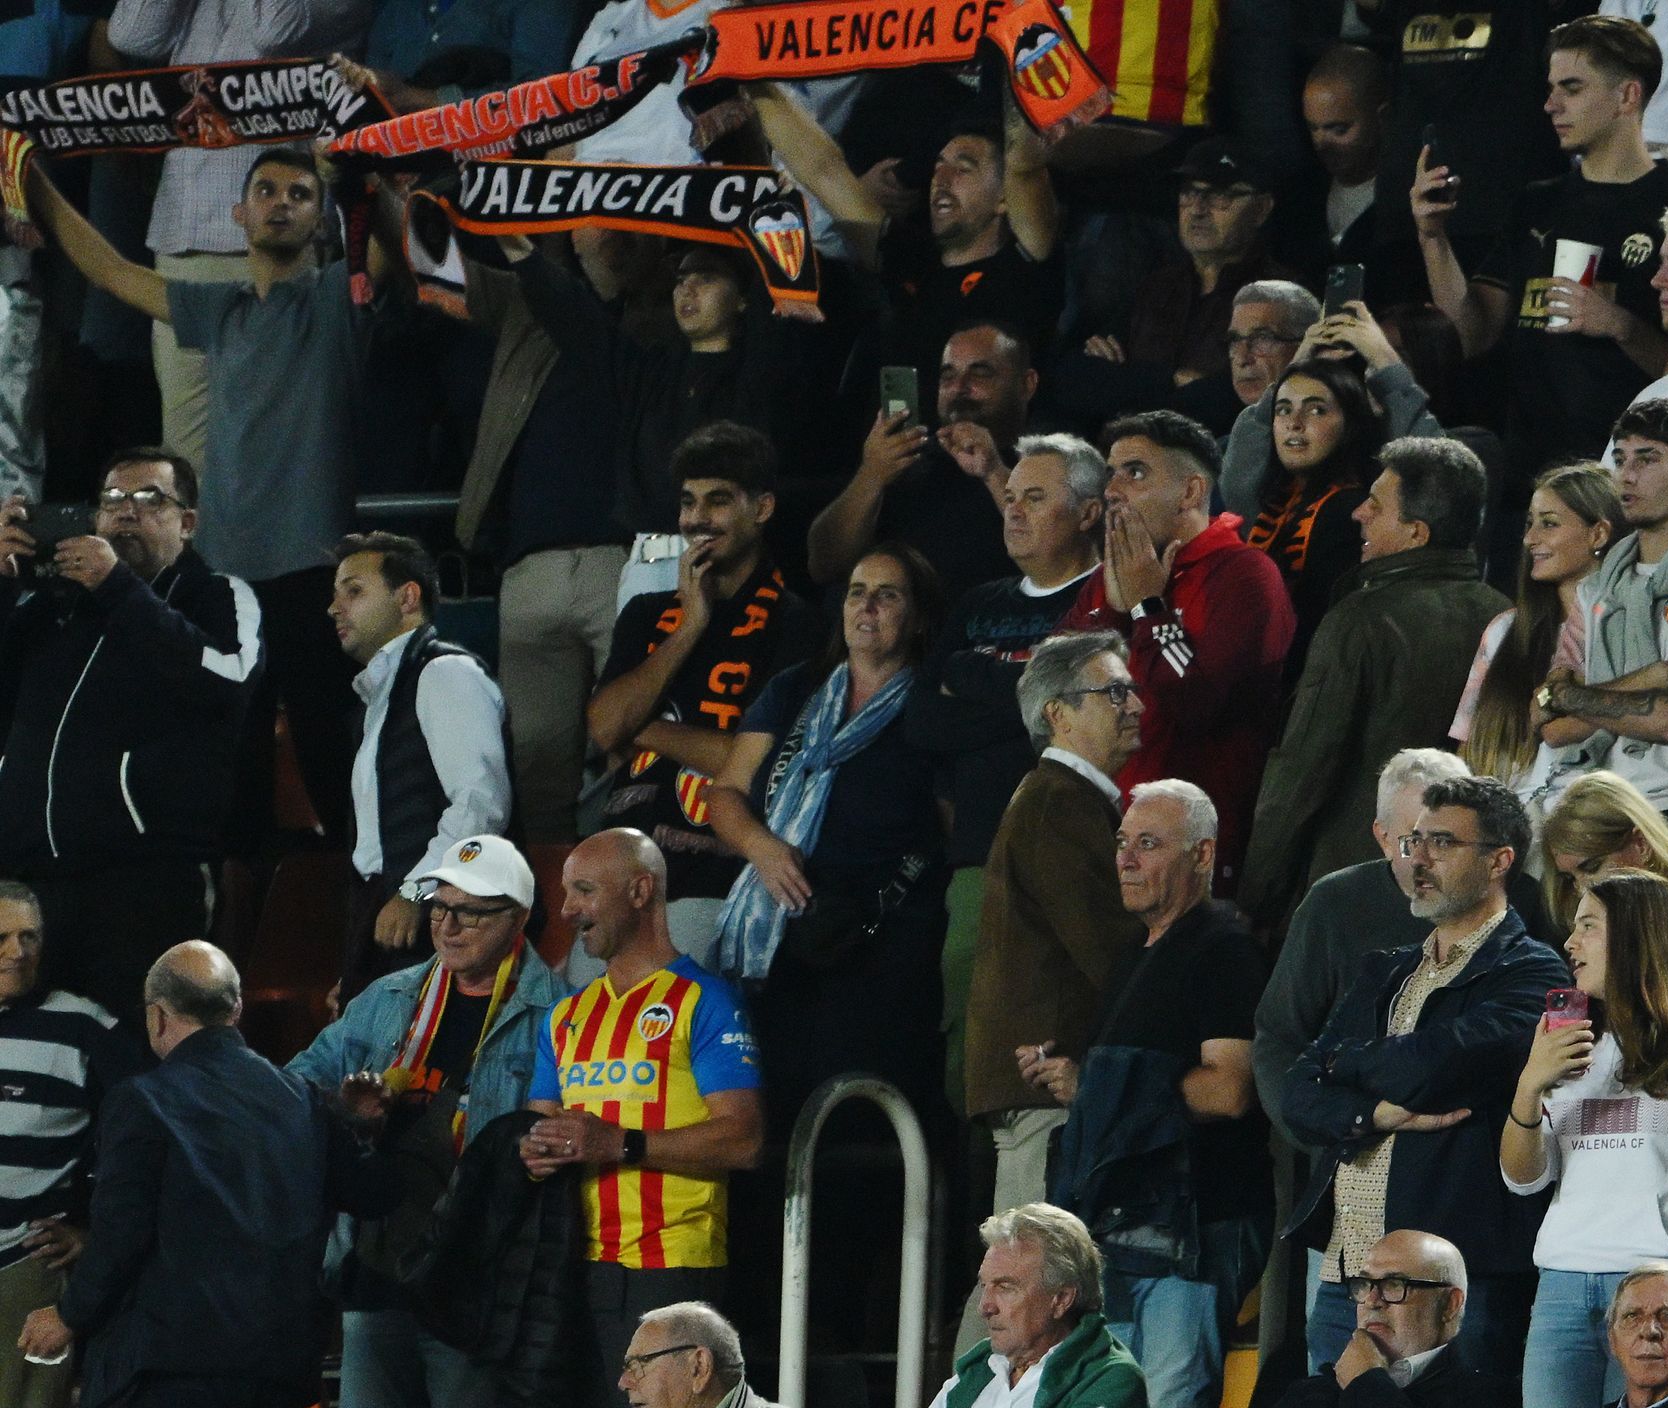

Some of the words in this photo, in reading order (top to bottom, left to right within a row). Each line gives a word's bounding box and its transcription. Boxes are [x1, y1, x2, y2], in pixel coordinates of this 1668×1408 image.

[756, 11, 936, 60] VALENCIA
[2, 81, 165, 123] VALENCIA
[338, 78, 562, 157] VALENCIA
[458, 165, 686, 217] VALENCIA
[1571, 1137, 1627, 1151] VALENCIA
[1630, 1138, 1645, 1149] CF
